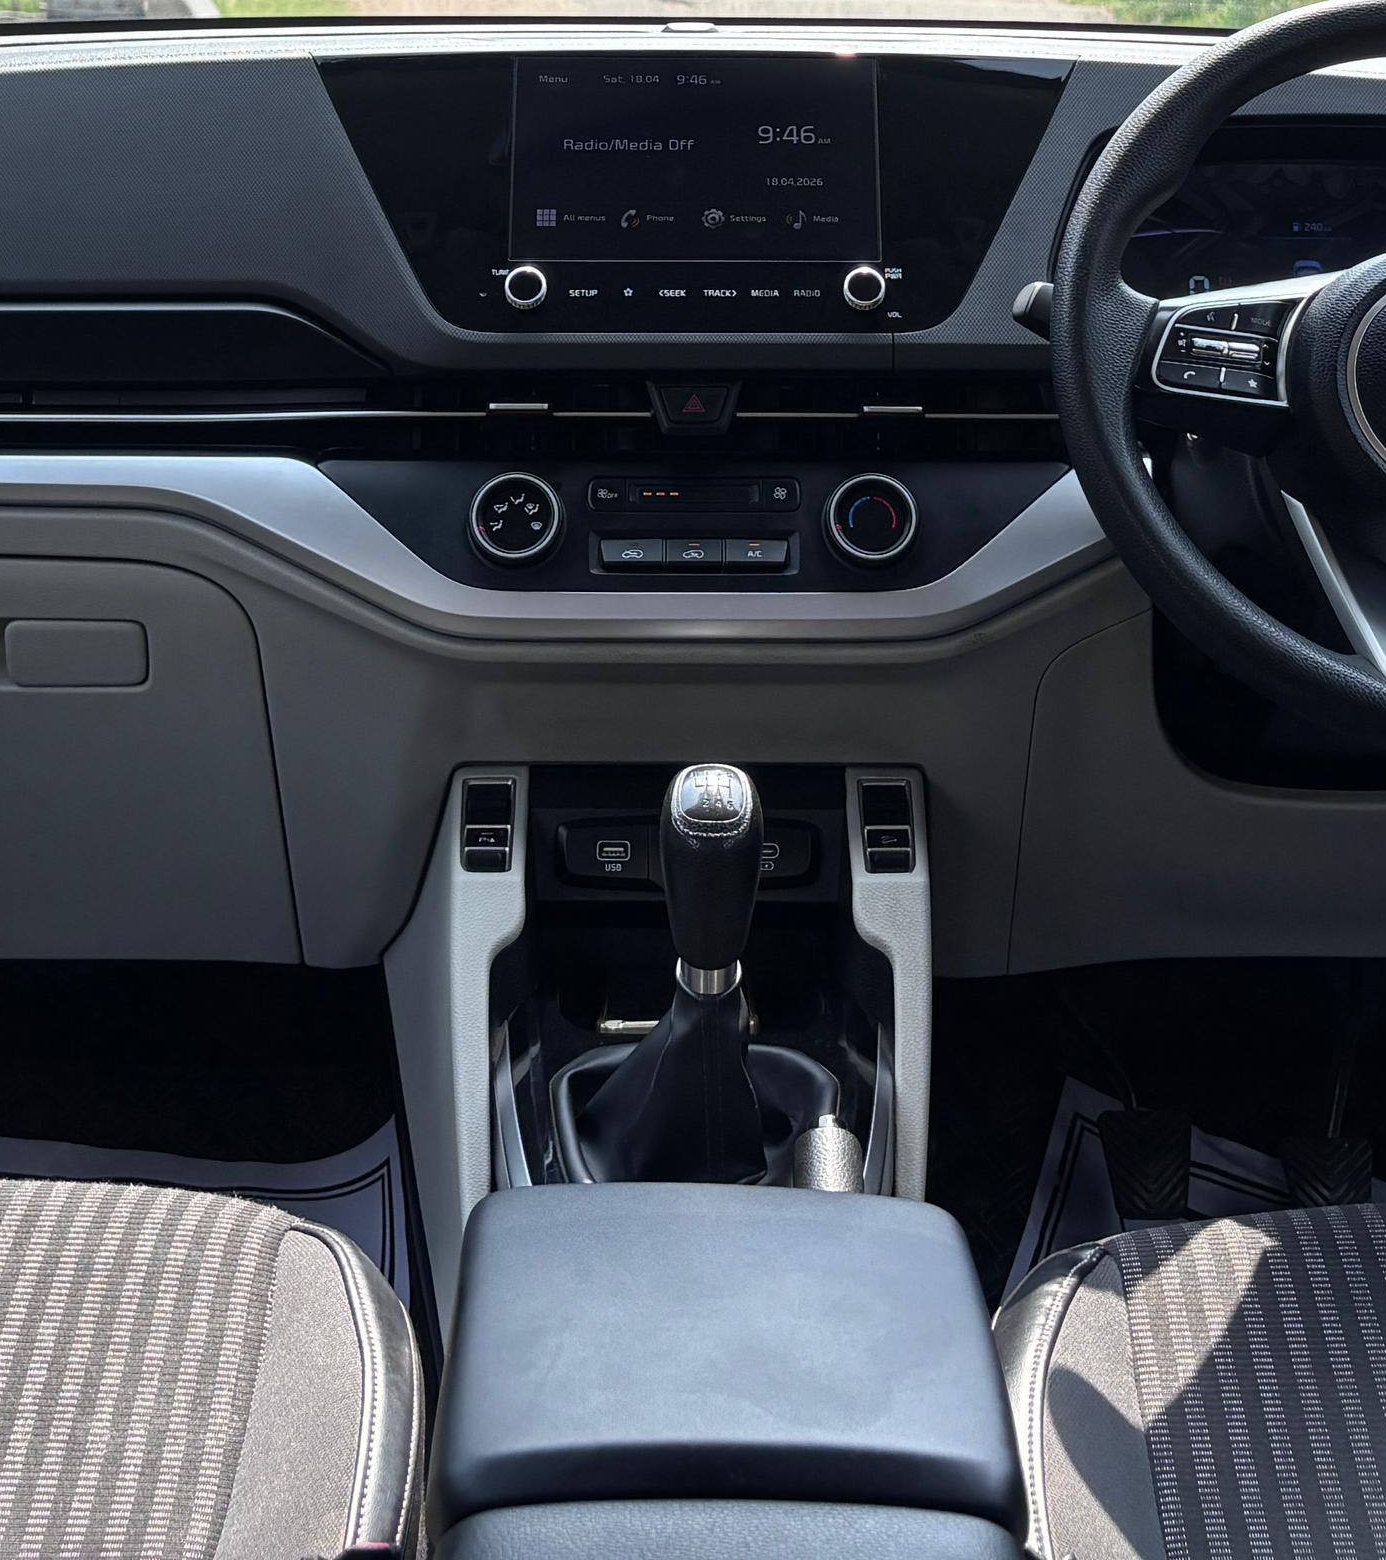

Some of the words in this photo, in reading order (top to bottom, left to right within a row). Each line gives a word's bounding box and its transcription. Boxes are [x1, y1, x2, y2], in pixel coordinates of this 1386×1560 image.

[538, 74, 569, 83] Menu
[629, 74, 660, 83] 18.04
[676, 74, 708, 85] 9:46
[758, 125, 816, 144] 9:46
[818, 137, 832, 145] AM
[563, 138, 663, 151] Radio/Media
[668, 138, 695, 151] Off
[765, 177, 824, 187] 18.04.2026
[563, 214, 576, 222] All
[646, 214, 675, 222] Phone
[729, 214, 767, 224] Settings
[813, 214, 840, 223] Media
[568, 289, 598, 297] SETUP
[750, 289, 780, 297] MEDIA
[793, 289, 821, 297] RADIO
[747, 550, 763, 558] A/C
[604, 863, 622, 872] USB
